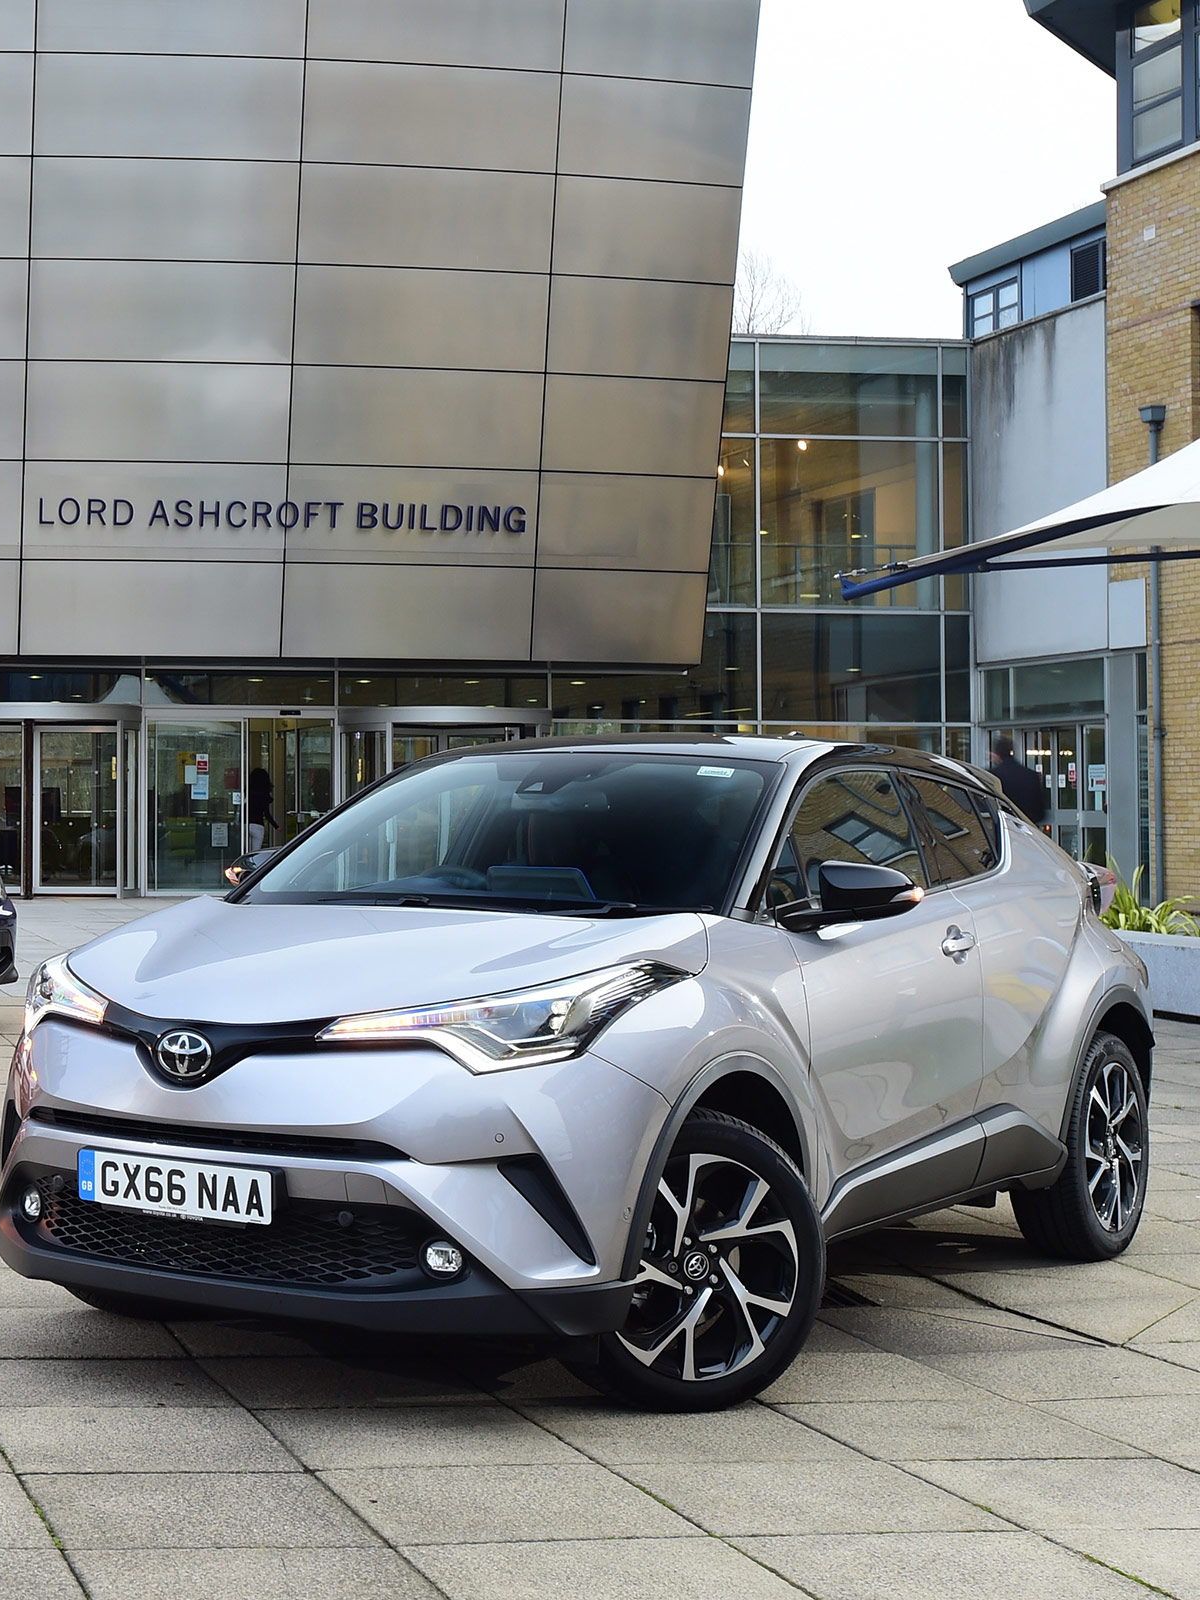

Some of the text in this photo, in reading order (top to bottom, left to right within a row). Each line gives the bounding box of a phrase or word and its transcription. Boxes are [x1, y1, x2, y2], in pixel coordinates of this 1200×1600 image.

[38, 497, 527, 533] LORD ASHCROFT BUILDING
[81, 1160, 265, 1218] GB GX66 NAA
